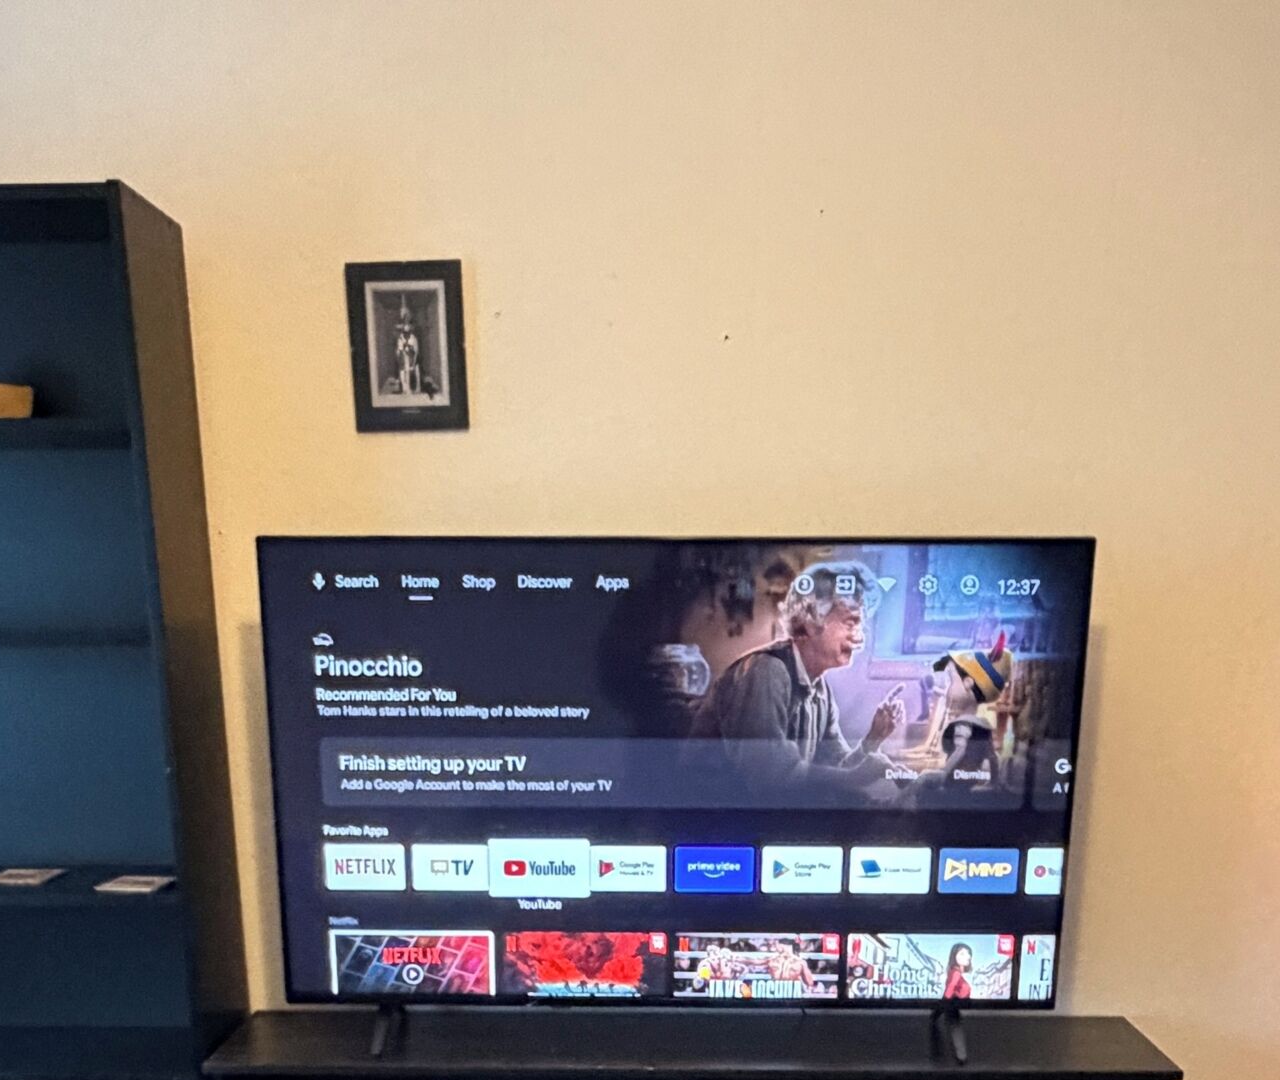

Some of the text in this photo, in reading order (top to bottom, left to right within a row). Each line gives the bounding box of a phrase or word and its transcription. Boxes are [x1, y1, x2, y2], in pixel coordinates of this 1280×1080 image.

[335, 574, 379, 588] Search
[401, 574, 439, 588] Home
[462, 574, 496, 591] Shop
[517, 574, 573, 589] Discover
[596, 575, 630, 591] Apps
[997, 579, 1040, 596] 12:37
[315, 655, 423, 677] Pinocchio
[316, 687, 457, 701] Recommended For You
[317, 705, 590, 720] Tom Hanks stars in this retelling of a beloved story
[339, 754, 527, 775] Finish setting up your TV
[1055, 758, 1072, 775] G
[885, 769, 919, 780] Details
[953, 769, 992, 780] Dismiss
[341, 779, 613, 794] Add a Google Account to make the most of your TV
[322, 825, 389, 838] Favorite Apps
[334, 858, 397, 876] NETFLIX
[451, 859, 474, 876] TV
[529, 861, 576, 876] YouTube
[687, 861, 741, 872] prime video
[794, 861, 817, 871] Google
[969, 862, 1012, 878] MMP
[518, 899, 562, 910] YouTube
[381, 946, 442, 964] NETFLIX
[1027, 940, 1036, 955] N
[851, 977, 942, 998] Christmas
